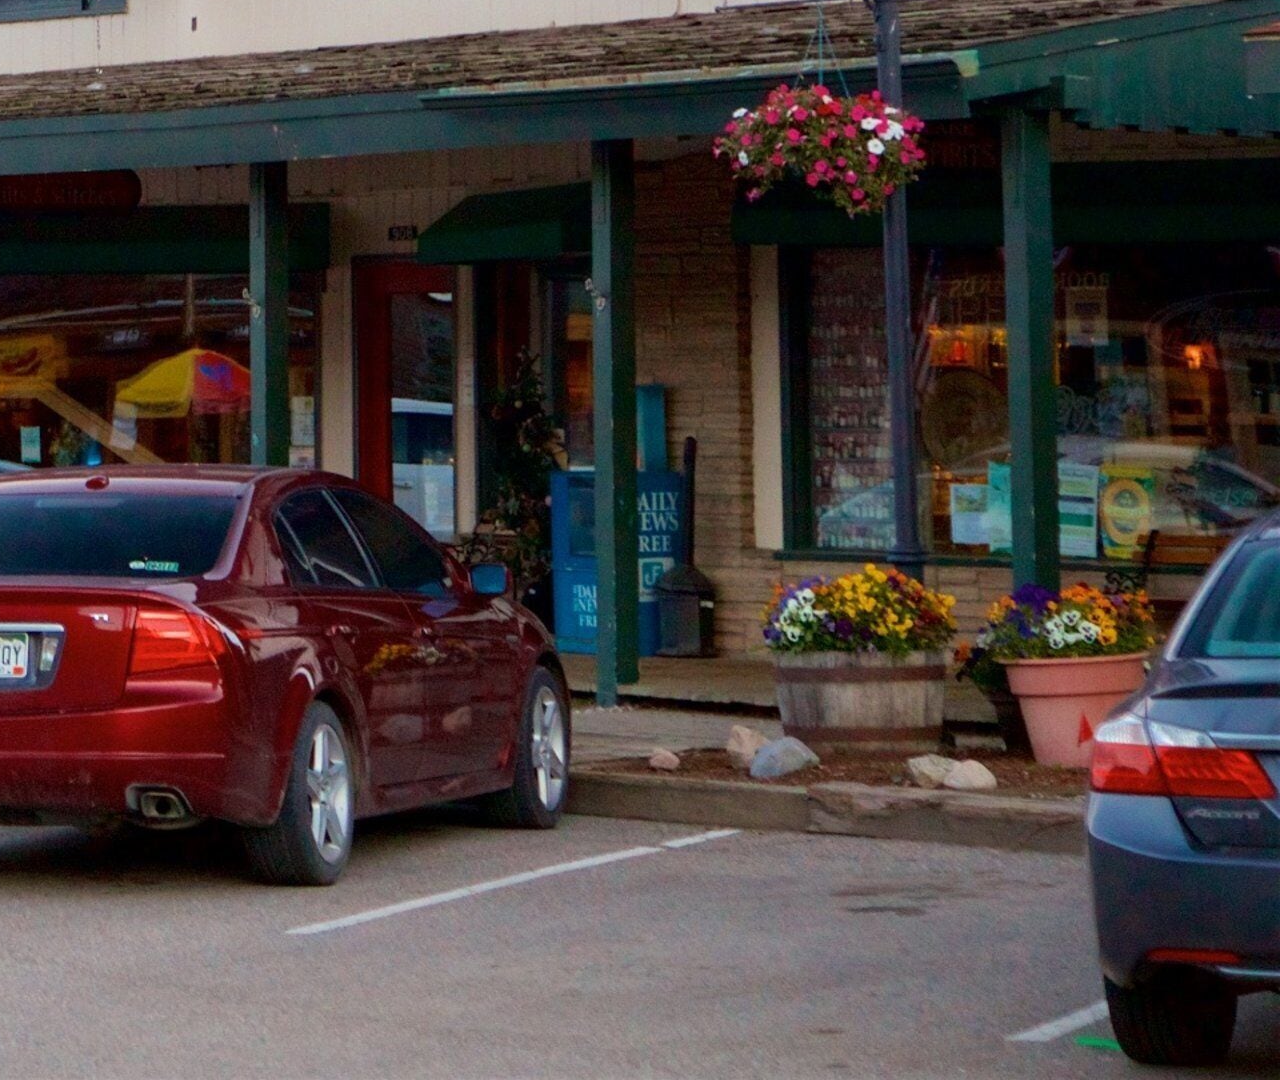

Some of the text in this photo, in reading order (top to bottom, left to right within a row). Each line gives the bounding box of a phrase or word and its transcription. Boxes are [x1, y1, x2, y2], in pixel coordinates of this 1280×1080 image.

[638, 491, 679, 512] AILY
[639, 512, 679, 532] EWS
[639, 535, 672, 553] REE
